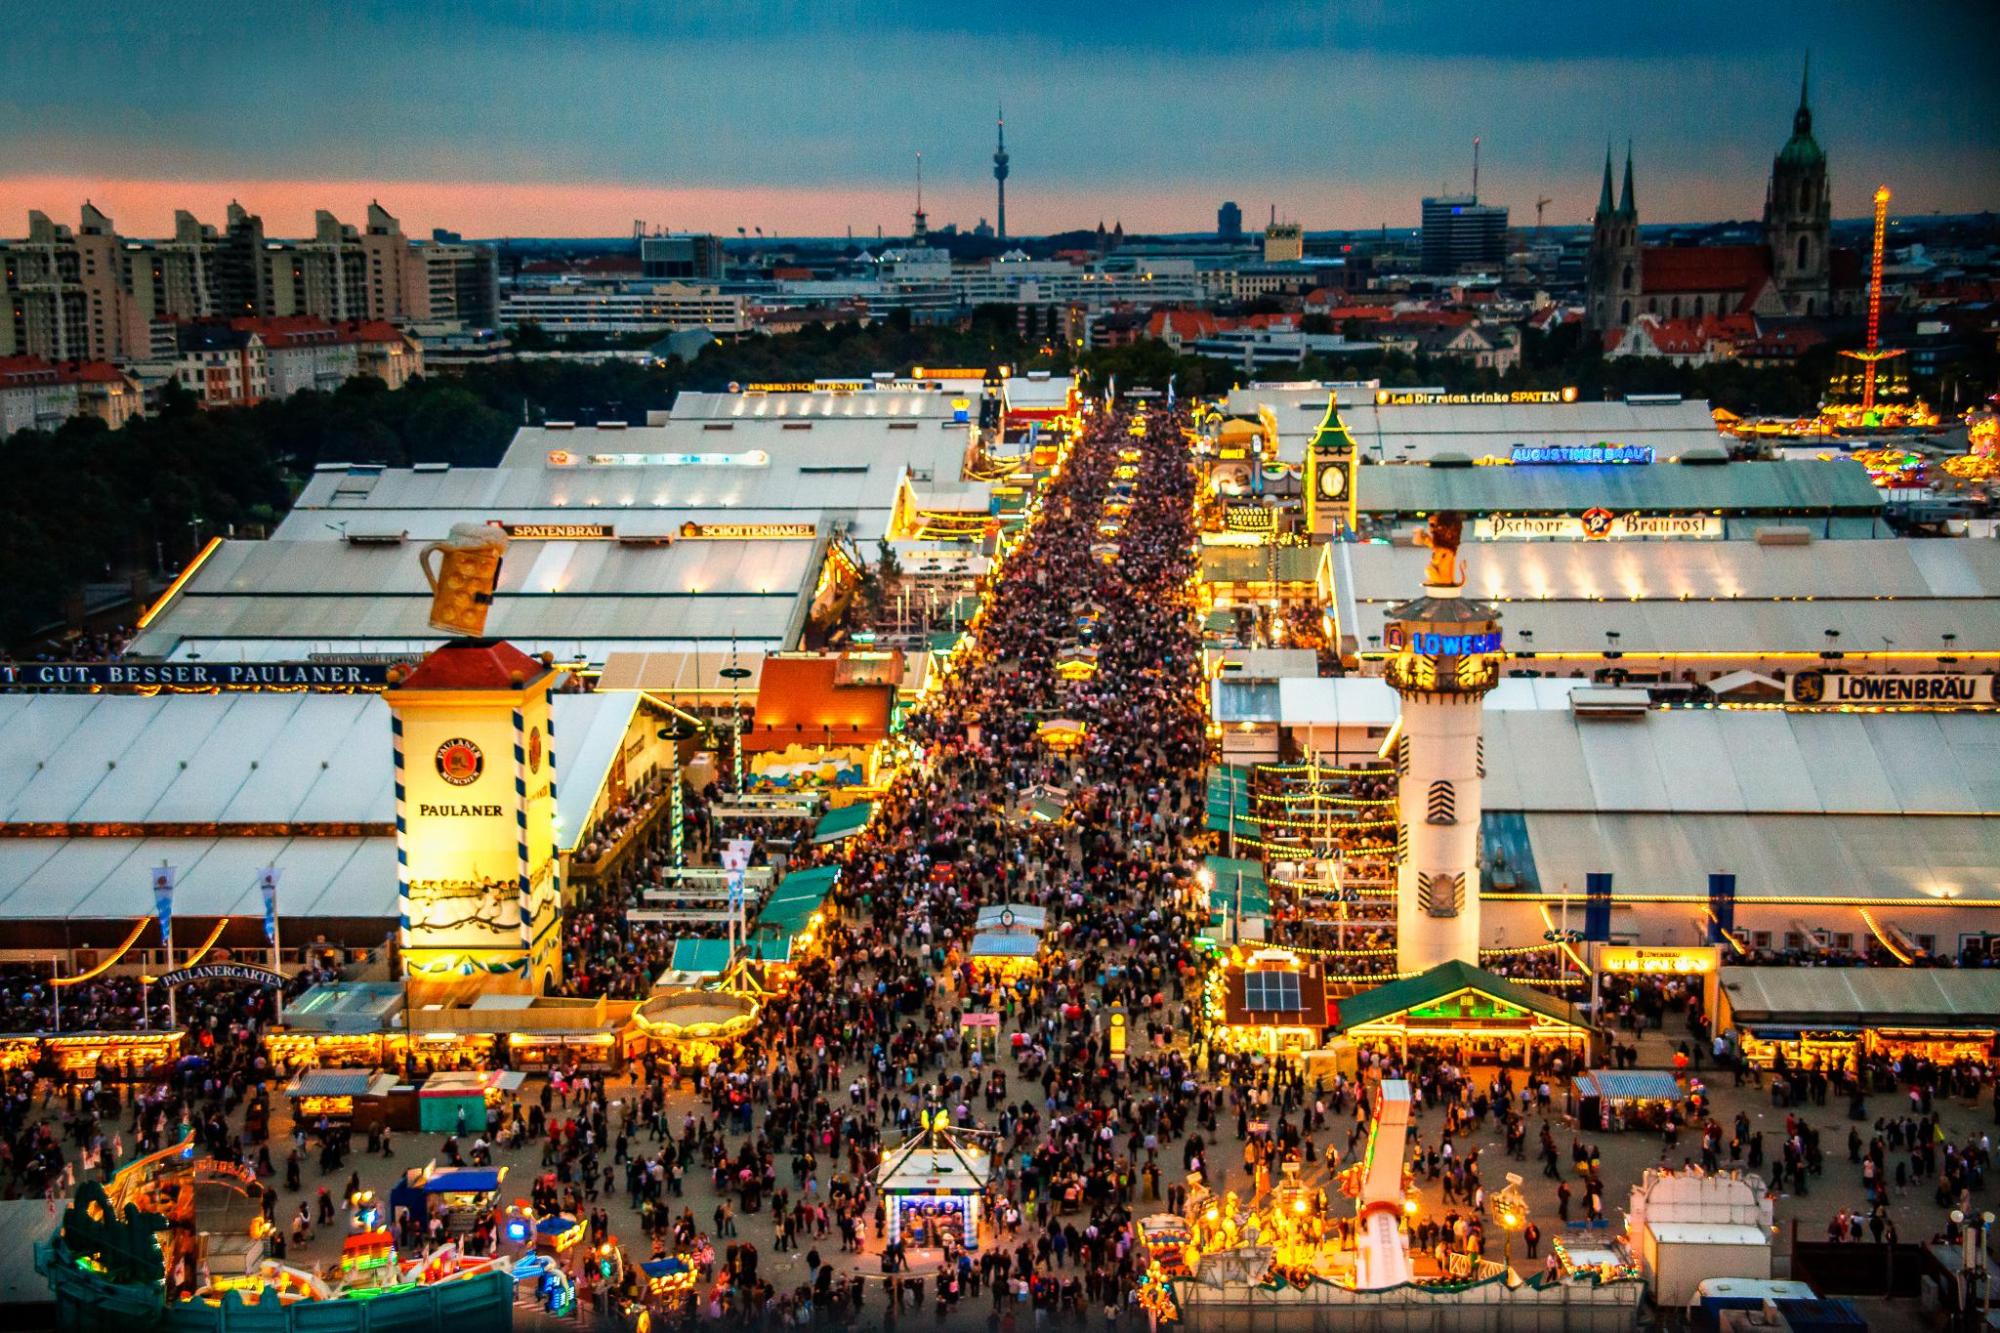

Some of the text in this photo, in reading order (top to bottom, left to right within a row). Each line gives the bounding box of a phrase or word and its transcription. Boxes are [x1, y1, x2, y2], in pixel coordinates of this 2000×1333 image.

[1415, 393, 1434, 404] Dir
[1436, 394, 1470, 403] raten
[1471, 393, 1509, 403] trinke
[1511, 392, 1560, 402] SPATEN
[1512, 447, 1602, 461] AUGUSTINER
[702, 525, 813, 537] SCHOTTENHAMEL
[39, 666, 97, 683] GUT,
[110, 666, 217, 683] BESSER,
[230, 666, 371, 683] PAULANER.
[1837, 675, 1976, 700] LÖWENBRÄU
[437, 739, 482, 760] PAULANER
[419, 804, 504, 817] PAULANER
[164, 966, 285, 987] PAULANERGARTEN
